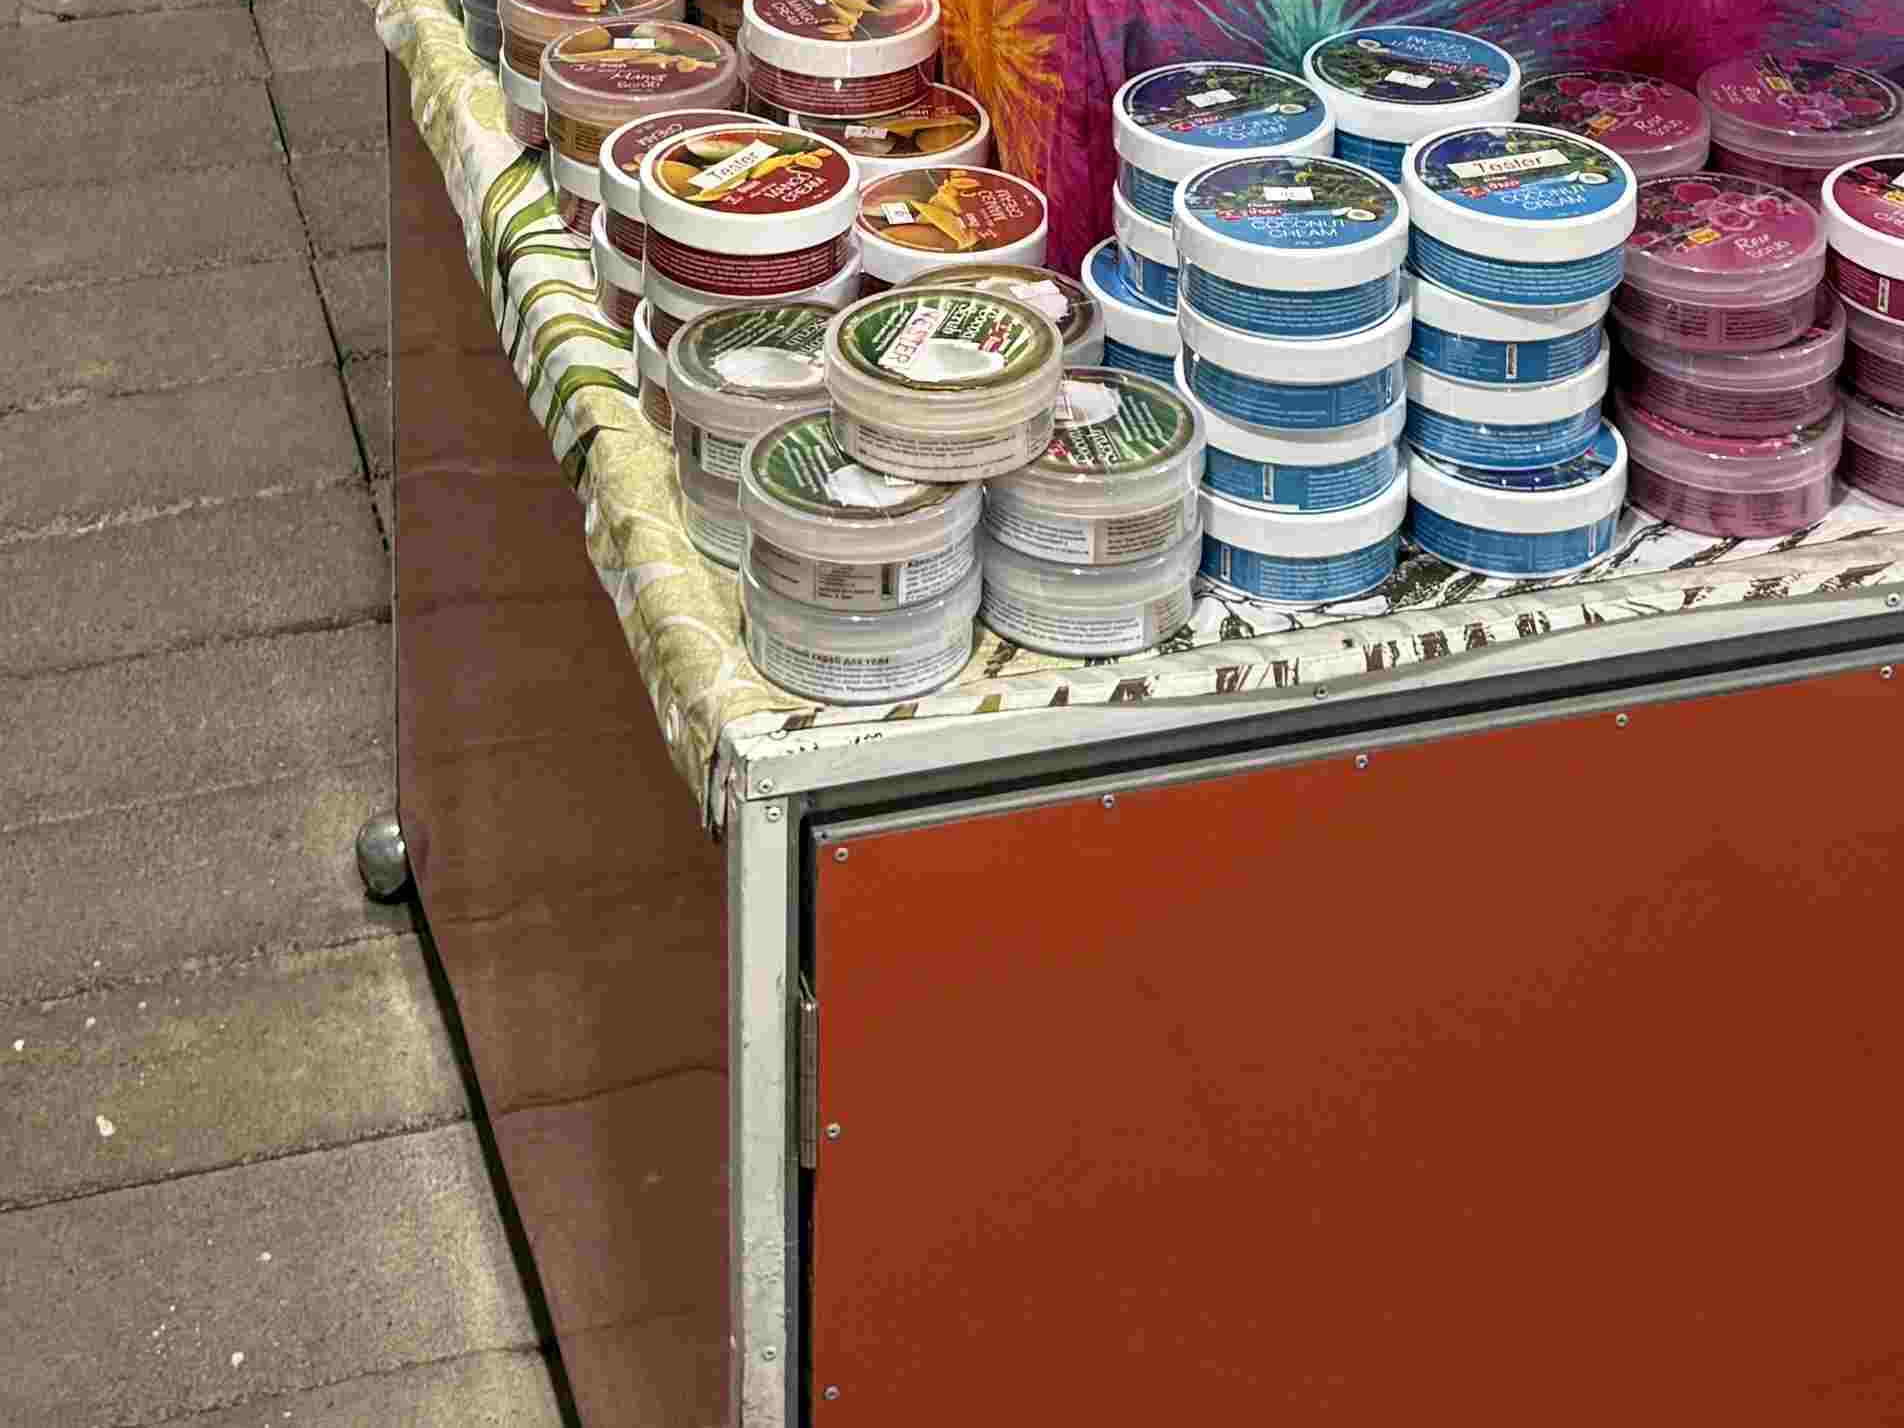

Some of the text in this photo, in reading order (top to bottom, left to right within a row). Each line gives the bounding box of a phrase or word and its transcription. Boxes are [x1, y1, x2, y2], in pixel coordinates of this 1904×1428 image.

[708, 149, 762, 183] Tester
[1472, 154, 1544, 175] Tester
[1499, 182, 1586, 204] COCONUT
[1520, 196, 1587, 212] CREAM
[1247, 217, 1347, 232] COCONUT
[1268, 227, 1338, 240] CREAM
